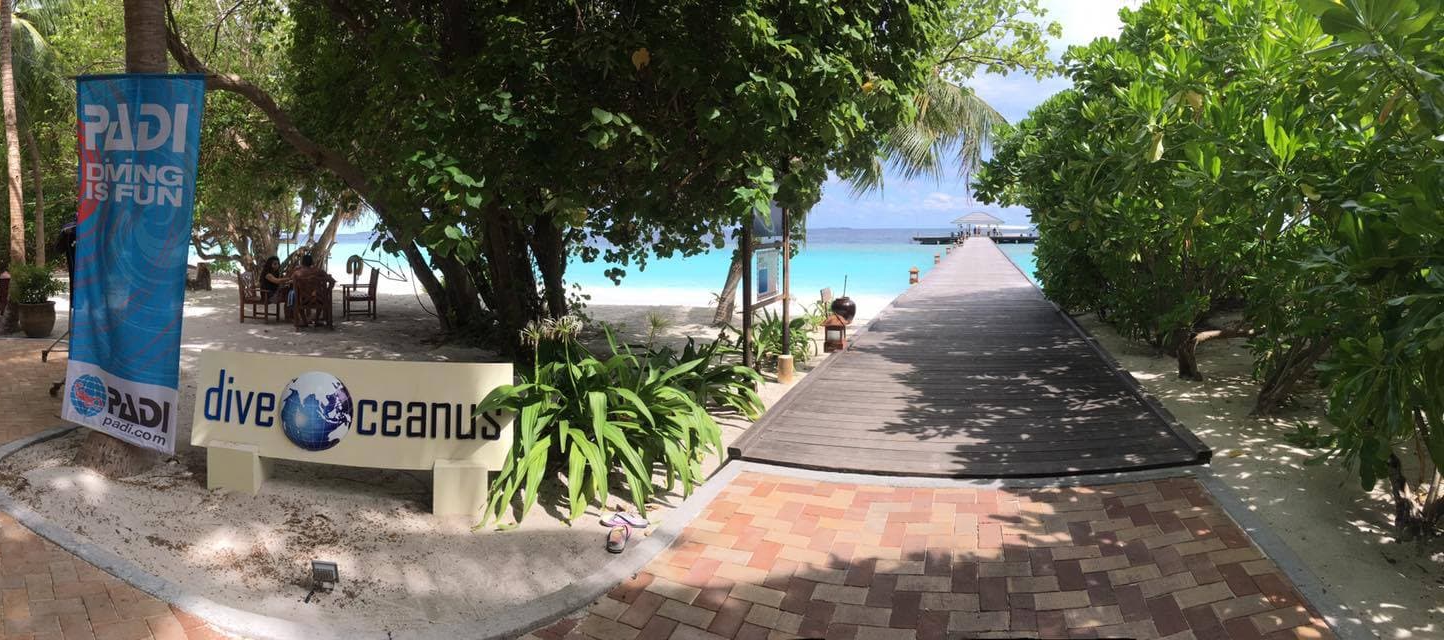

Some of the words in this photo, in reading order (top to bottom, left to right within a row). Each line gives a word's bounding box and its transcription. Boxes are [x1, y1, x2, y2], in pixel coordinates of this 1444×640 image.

[84, 103, 189, 152] PADI
[86, 182, 109, 201] IS
[115, 184, 183, 207] FUN
[107, 386, 170, 434] PADI
[204, 368, 276, 428] dive
[102, 416, 166, 446] padi.com
